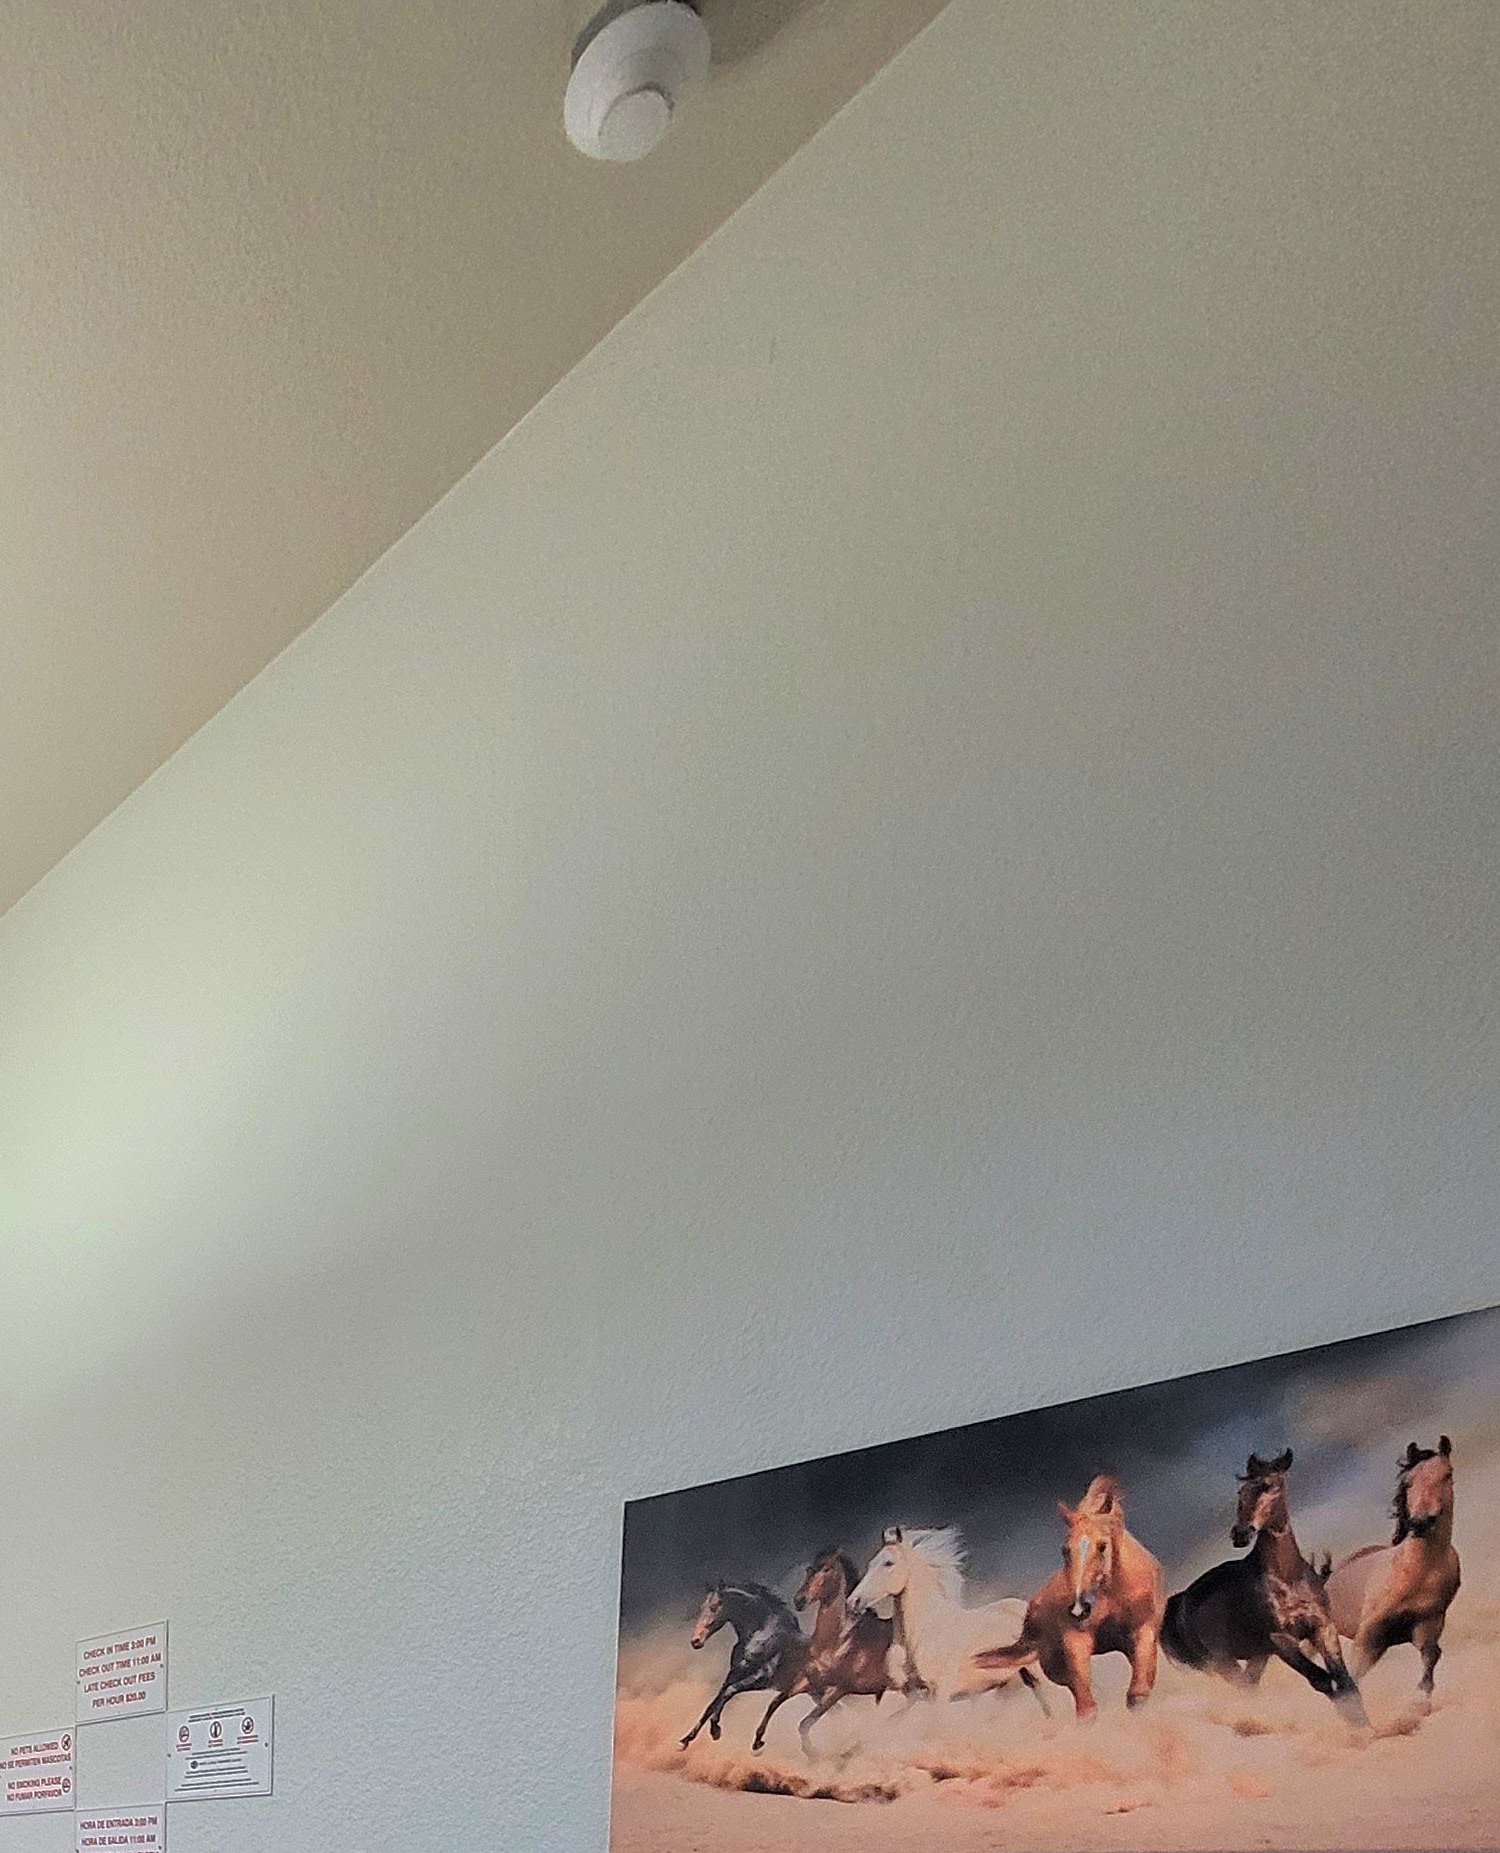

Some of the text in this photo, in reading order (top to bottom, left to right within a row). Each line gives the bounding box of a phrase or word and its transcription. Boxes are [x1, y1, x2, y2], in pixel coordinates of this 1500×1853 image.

[83, 1636, 156, 1660] CHECK IN TIME 3:00 PM
[79, 1653, 161, 1677] CHECK OUT TIME 11:00 AM
[84, 1672, 156, 1693] LATE CHECK OUT FEES
[92, 1698, 104, 1708] PER
[105, 1694, 124, 1705] HOUR
[11, 1742, 58, 1755] NO PETS ALLOWED
[42, 1753, 71, 1764] MASCOTAS
[17, 1779, 40, 1789] SMOKING
[41, 1776, 61, 1786] PLEASE
[7, 1793, 14, 1801] NO
[15, 1792, 32, 1800] FUMAR
[80, 1821, 96, 1829] HORA
[97, 1820, 105, 1829] DE
[106, 1818, 133, 1828] ENTRADA
[148, 1816, 157, 1825] PM
[82, 1837, 97, 1846] HORA
[99, 1837, 106, 1845] DE
[108, 1836, 128, 1845] SALIDA
[146, 1834, 156, 1842] AM
